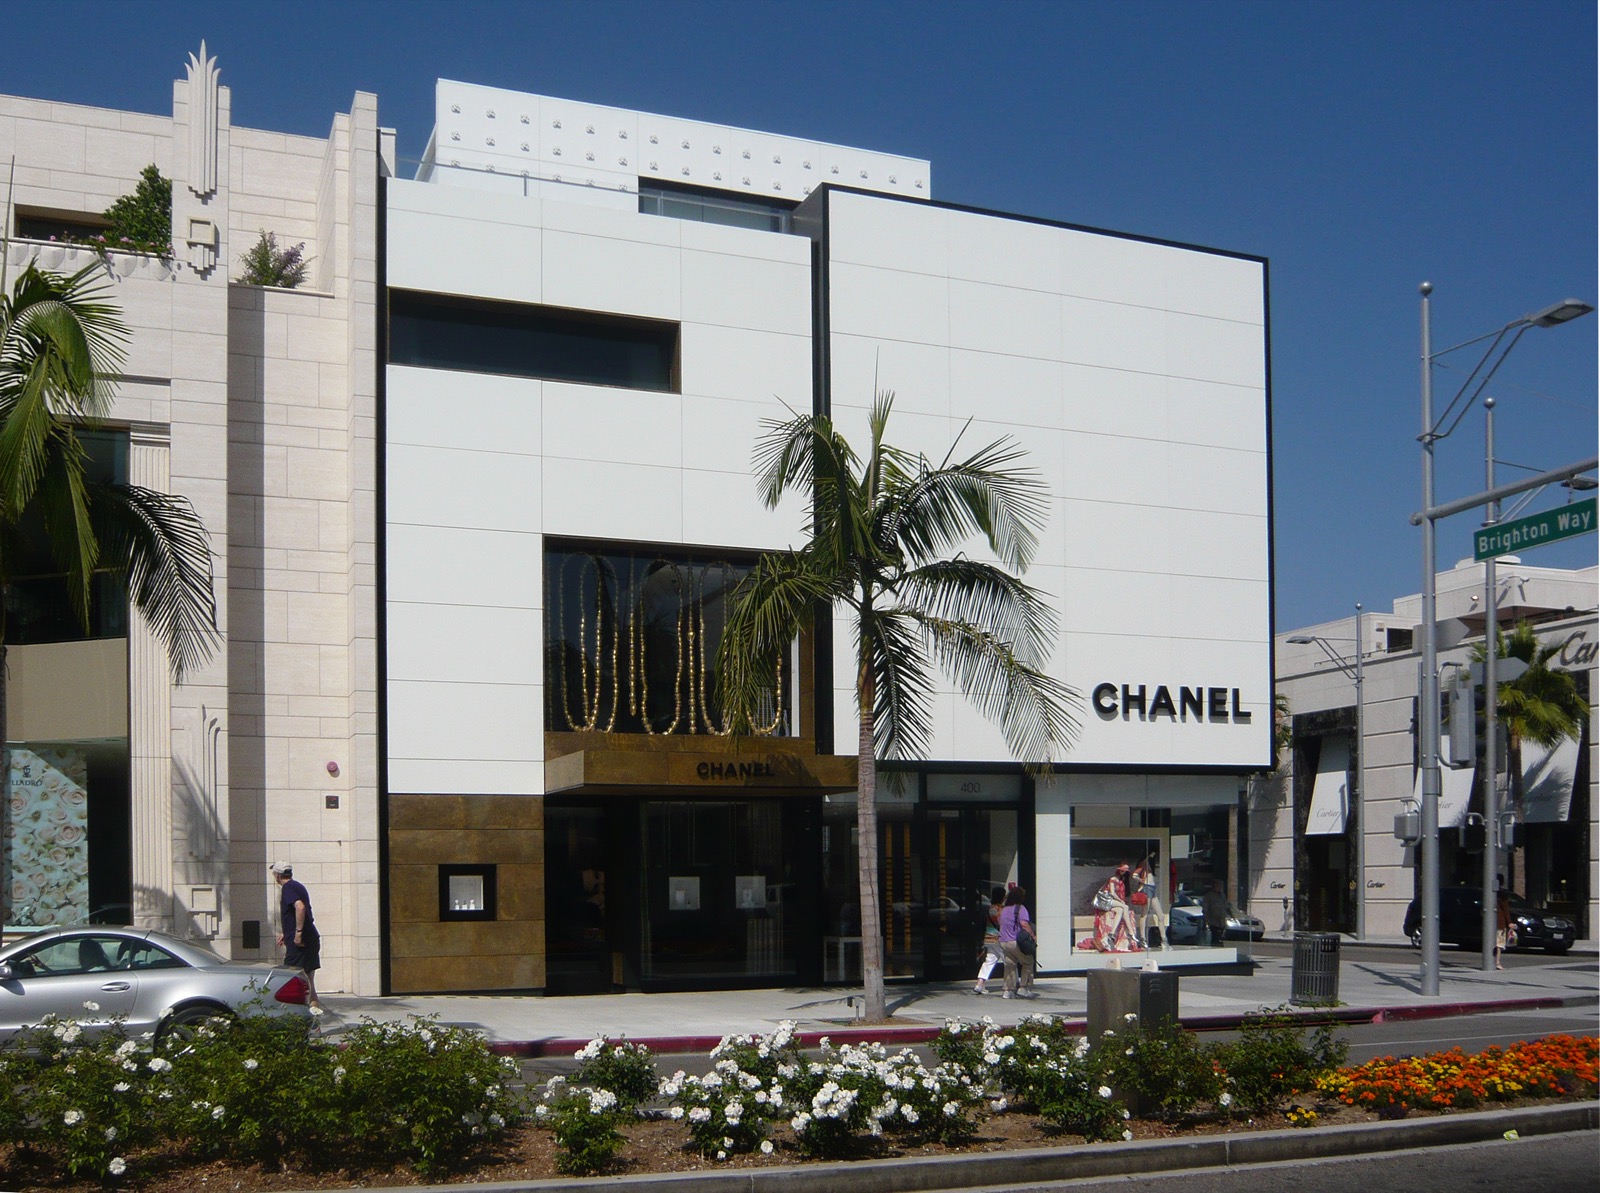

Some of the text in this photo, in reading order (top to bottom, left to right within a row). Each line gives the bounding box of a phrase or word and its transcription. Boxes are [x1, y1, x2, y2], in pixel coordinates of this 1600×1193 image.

[1479, 510, 1591, 553] Brighton Way
[1092, 682, 1252, 718] CHANEL
[696, 762, 776, 778] CHANEL
[960, 782, 981, 793] 400
[1316, 807, 1340, 818] Cartier
[1270, 881, 1286, 889] Cartier
[1366, 879, 1386, 889] Cartier
